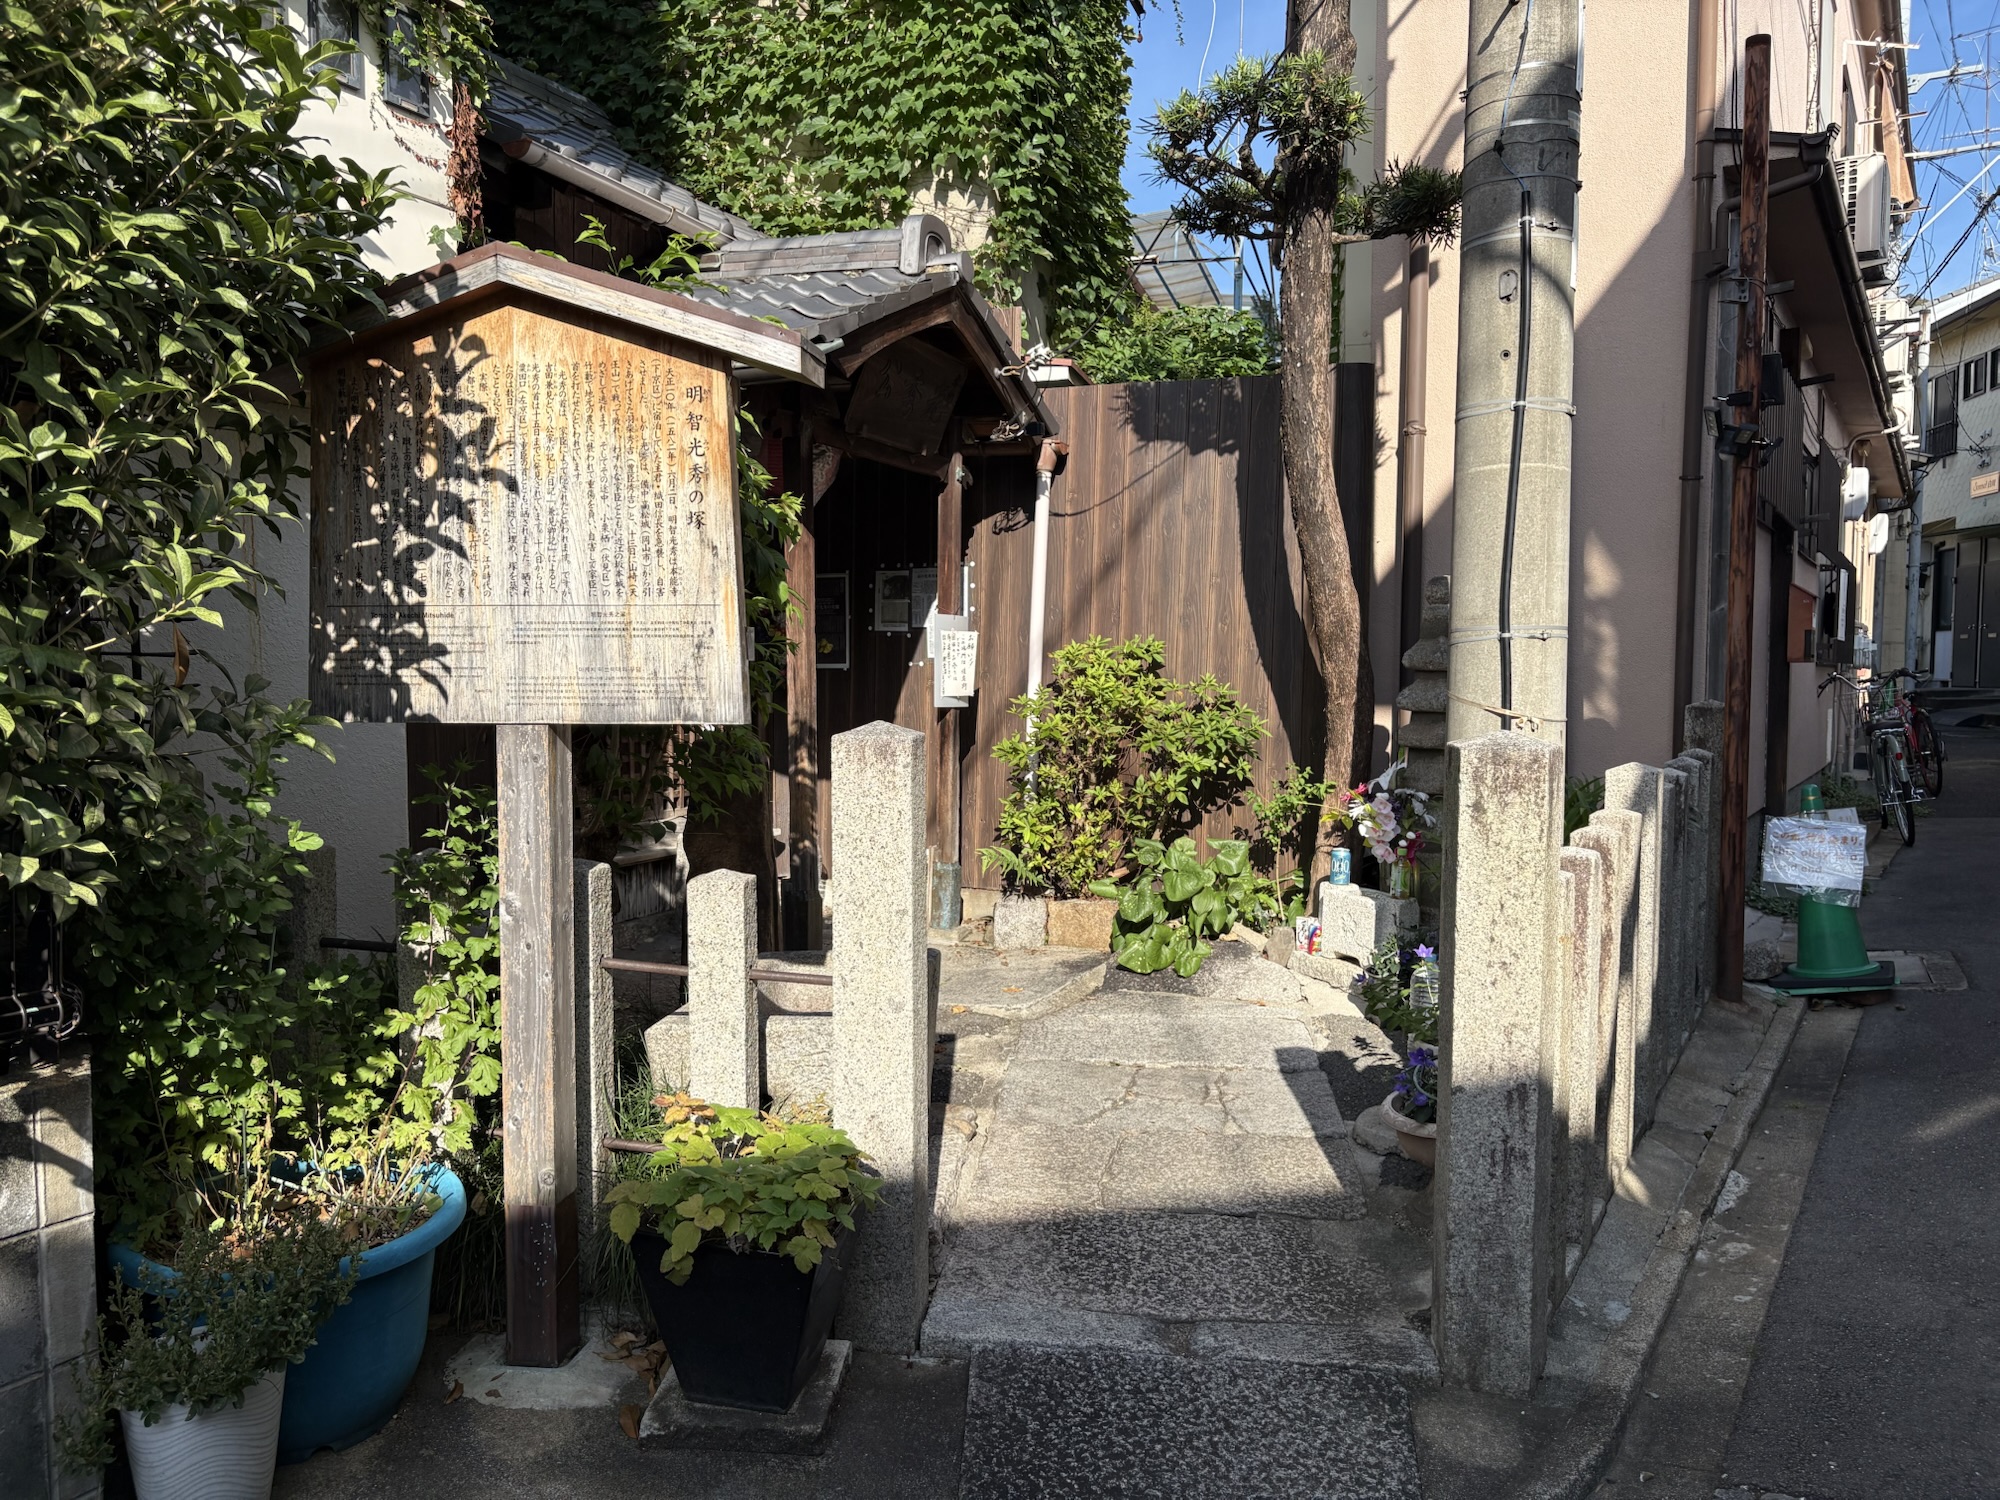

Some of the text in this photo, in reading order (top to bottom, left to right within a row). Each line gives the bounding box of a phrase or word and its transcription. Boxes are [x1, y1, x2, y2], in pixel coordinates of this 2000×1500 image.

[685, 385, 706, 530] 明智光秀の塚
